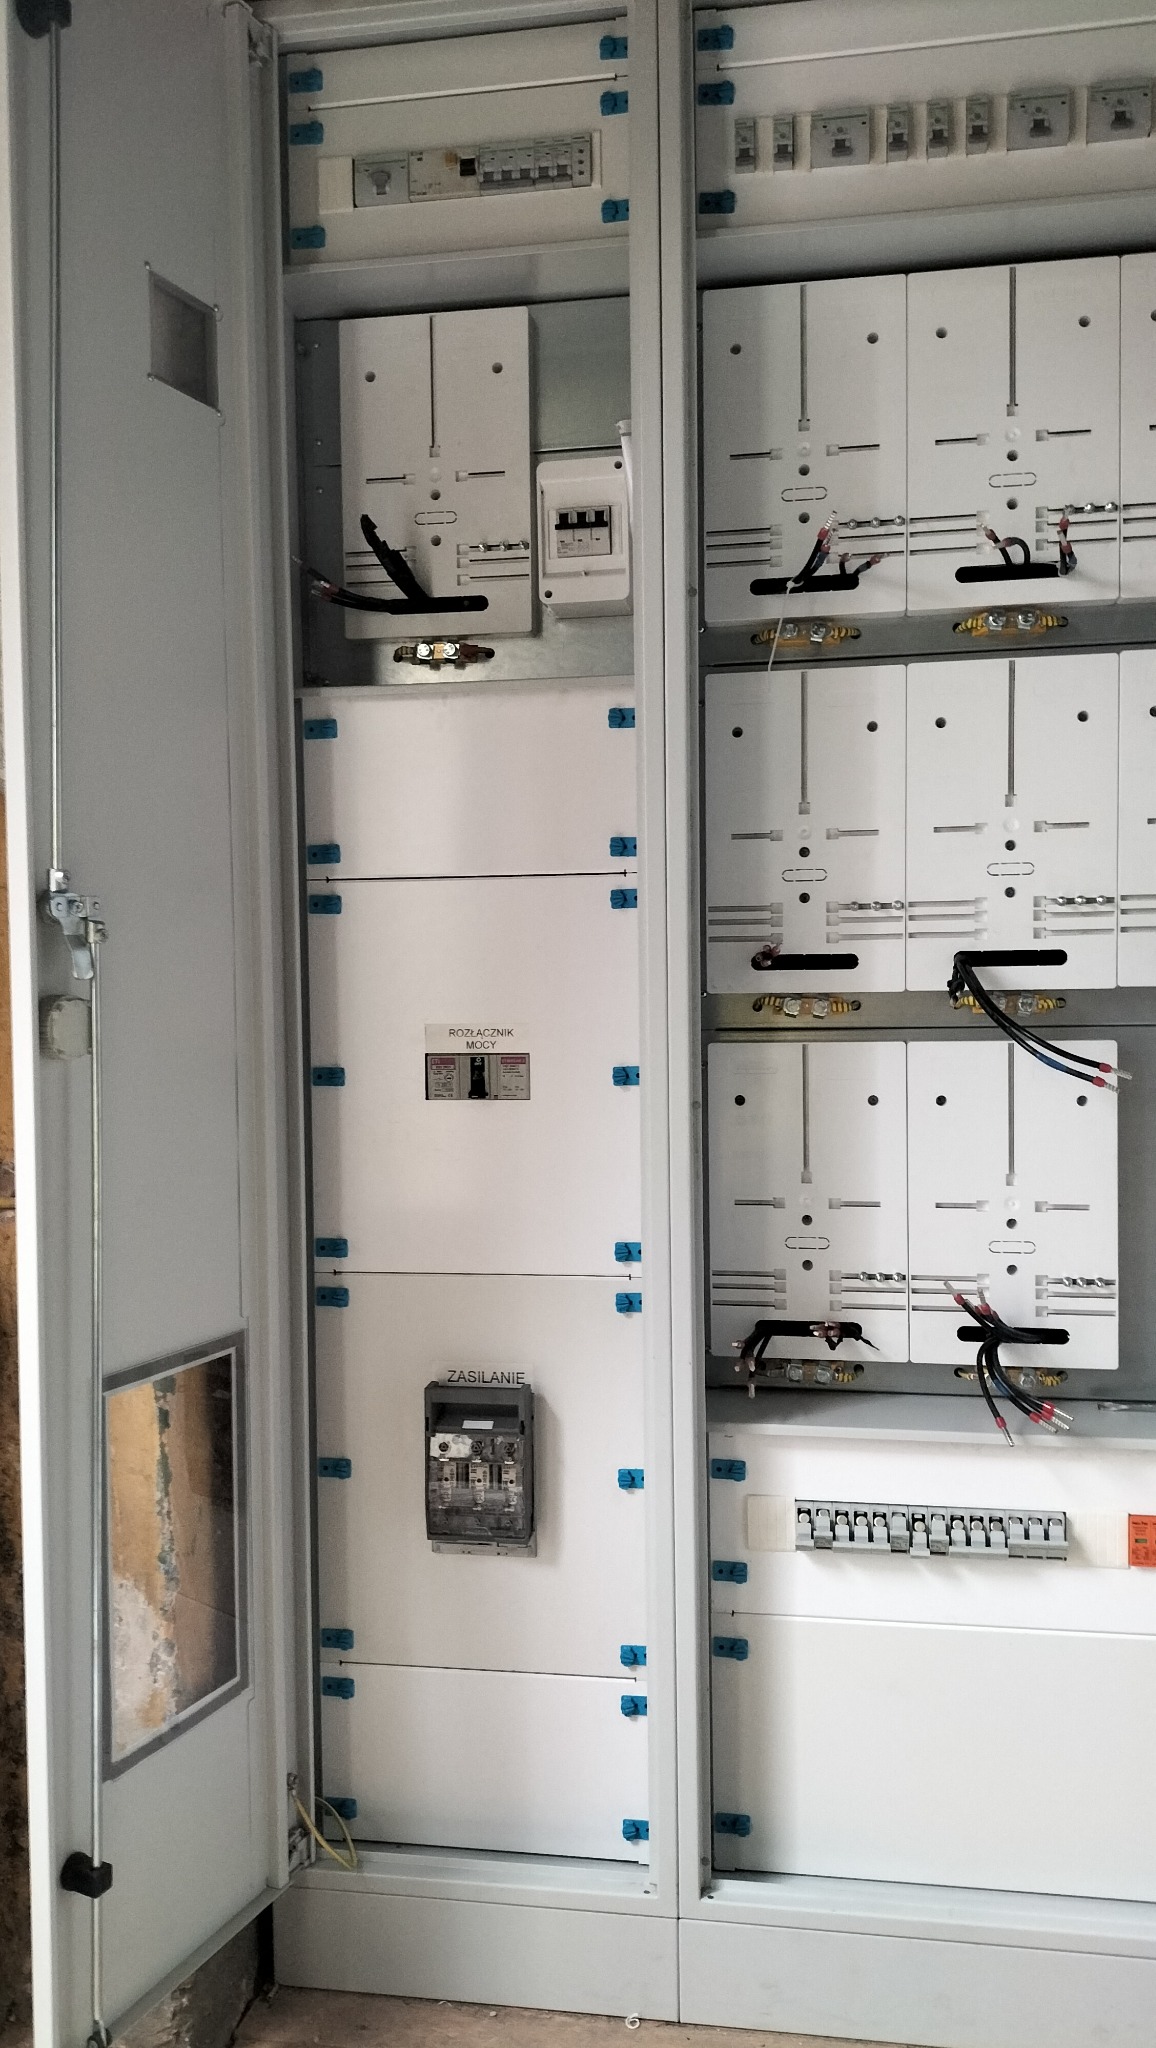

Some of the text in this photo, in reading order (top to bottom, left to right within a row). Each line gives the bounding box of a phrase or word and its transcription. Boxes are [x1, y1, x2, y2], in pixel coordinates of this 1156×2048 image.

[448, 1028, 514, 1040] ROZŁĄCZNIK
[466, 1040, 497, 1050] MOCY
[447, 1369, 526, 1385] ZASILANIE
